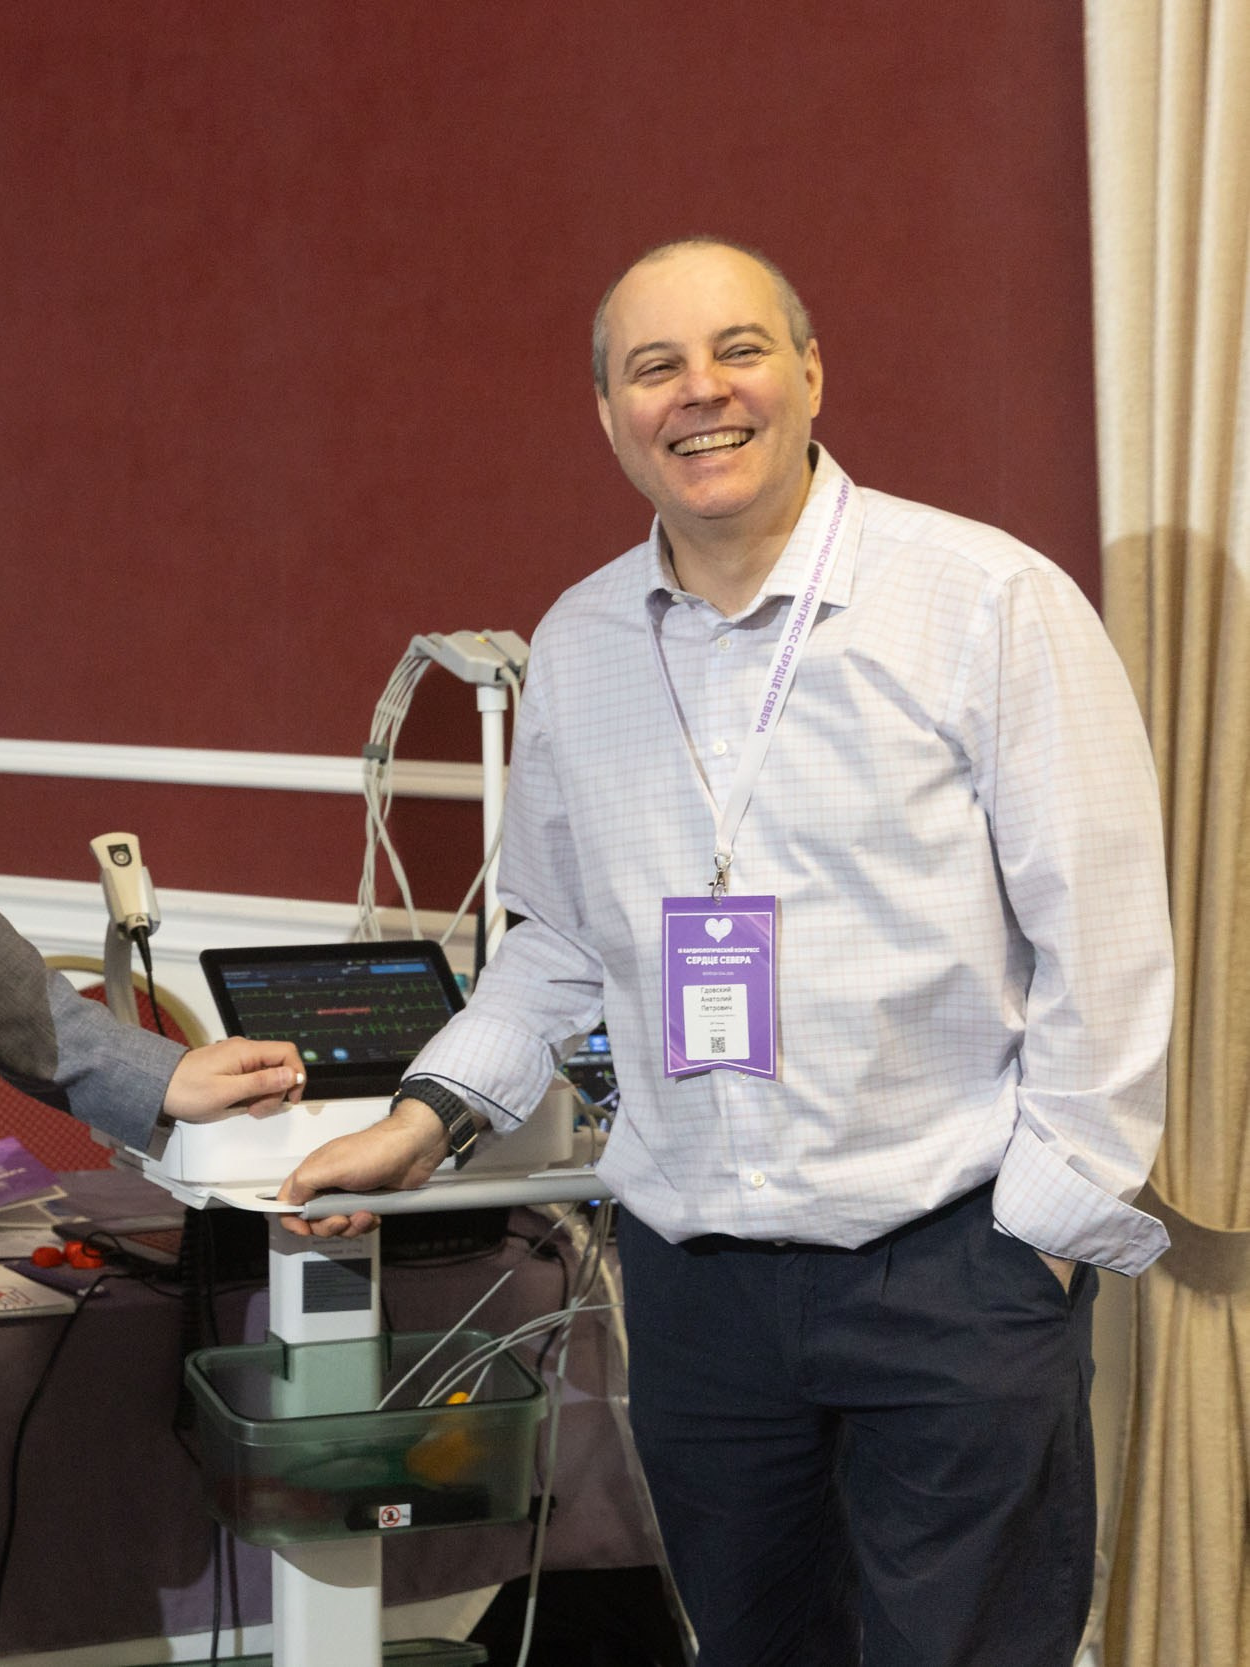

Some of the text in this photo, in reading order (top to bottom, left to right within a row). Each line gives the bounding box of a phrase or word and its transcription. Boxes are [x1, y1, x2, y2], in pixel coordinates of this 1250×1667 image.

[788, 584, 818, 644] КОНГРЕСС
[771, 645, 795, 691] СЕРДЦЕ
[755, 691, 778, 733] СЕВЕРА
[686, 955, 752, 966] СЕРДЦЕ СЕВЕРА
